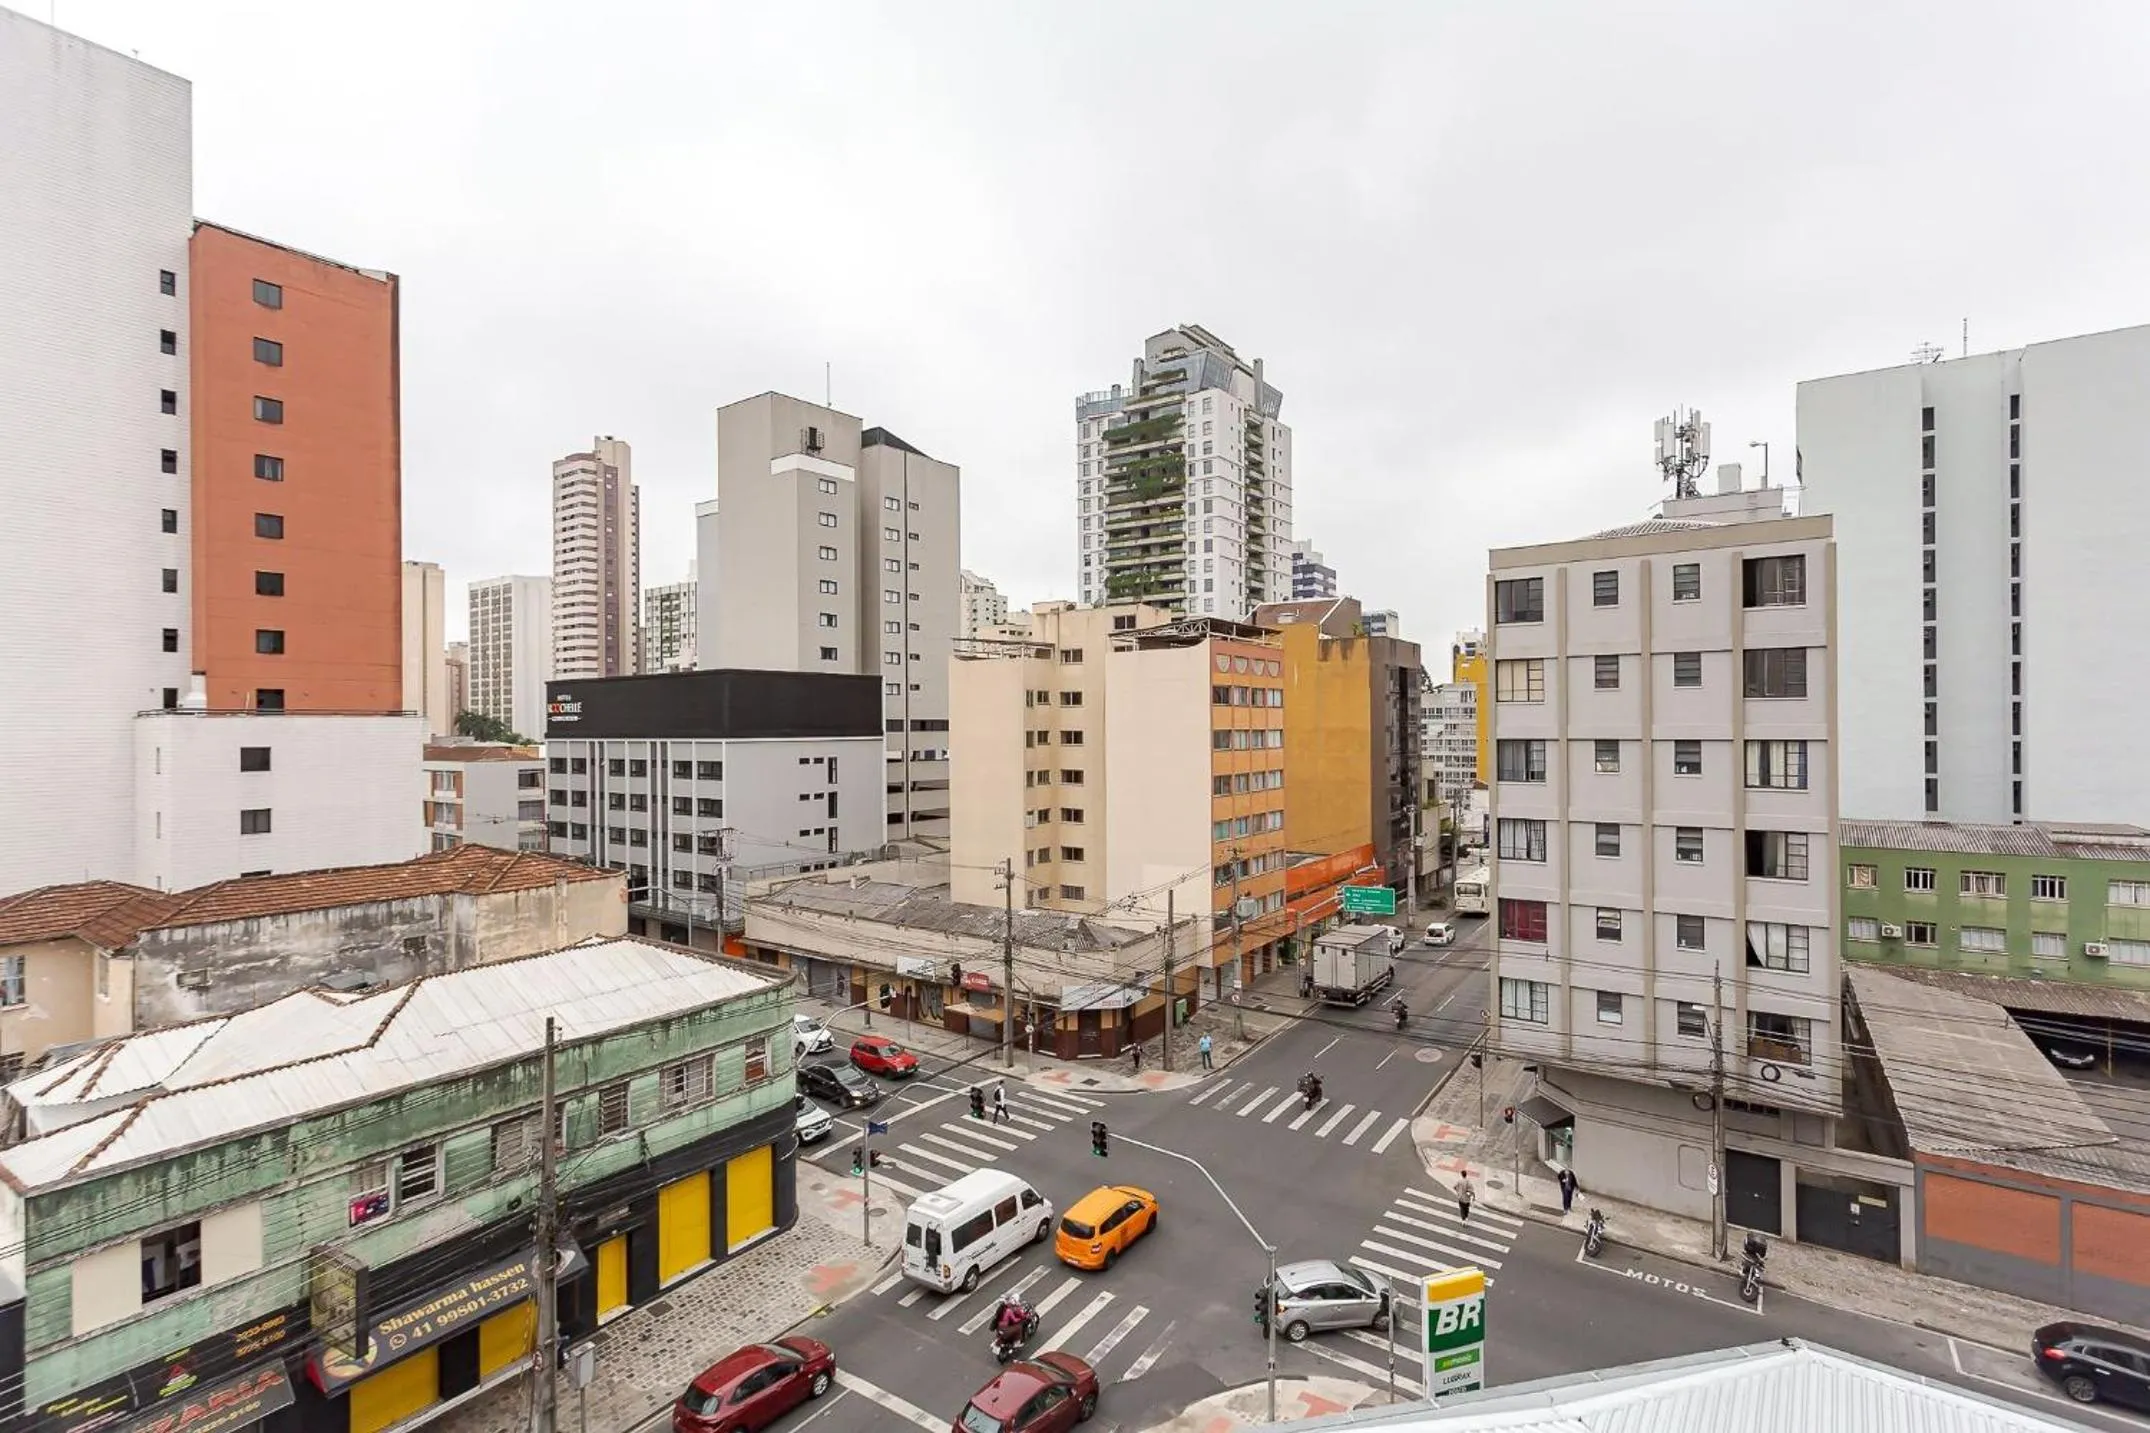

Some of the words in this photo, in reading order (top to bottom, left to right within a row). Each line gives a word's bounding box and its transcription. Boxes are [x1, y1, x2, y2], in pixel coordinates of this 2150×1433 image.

[378, 1288, 468, 1336] Shawarma
[469, 1262, 525, 1293] hassen
[412, 1320, 433, 1338] 41
[436, 1277, 529, 1327] 99801-3732
[1626, 1268, 1707, 1298] MOTOS
[1435, 1299, 1482, 1336] BR
